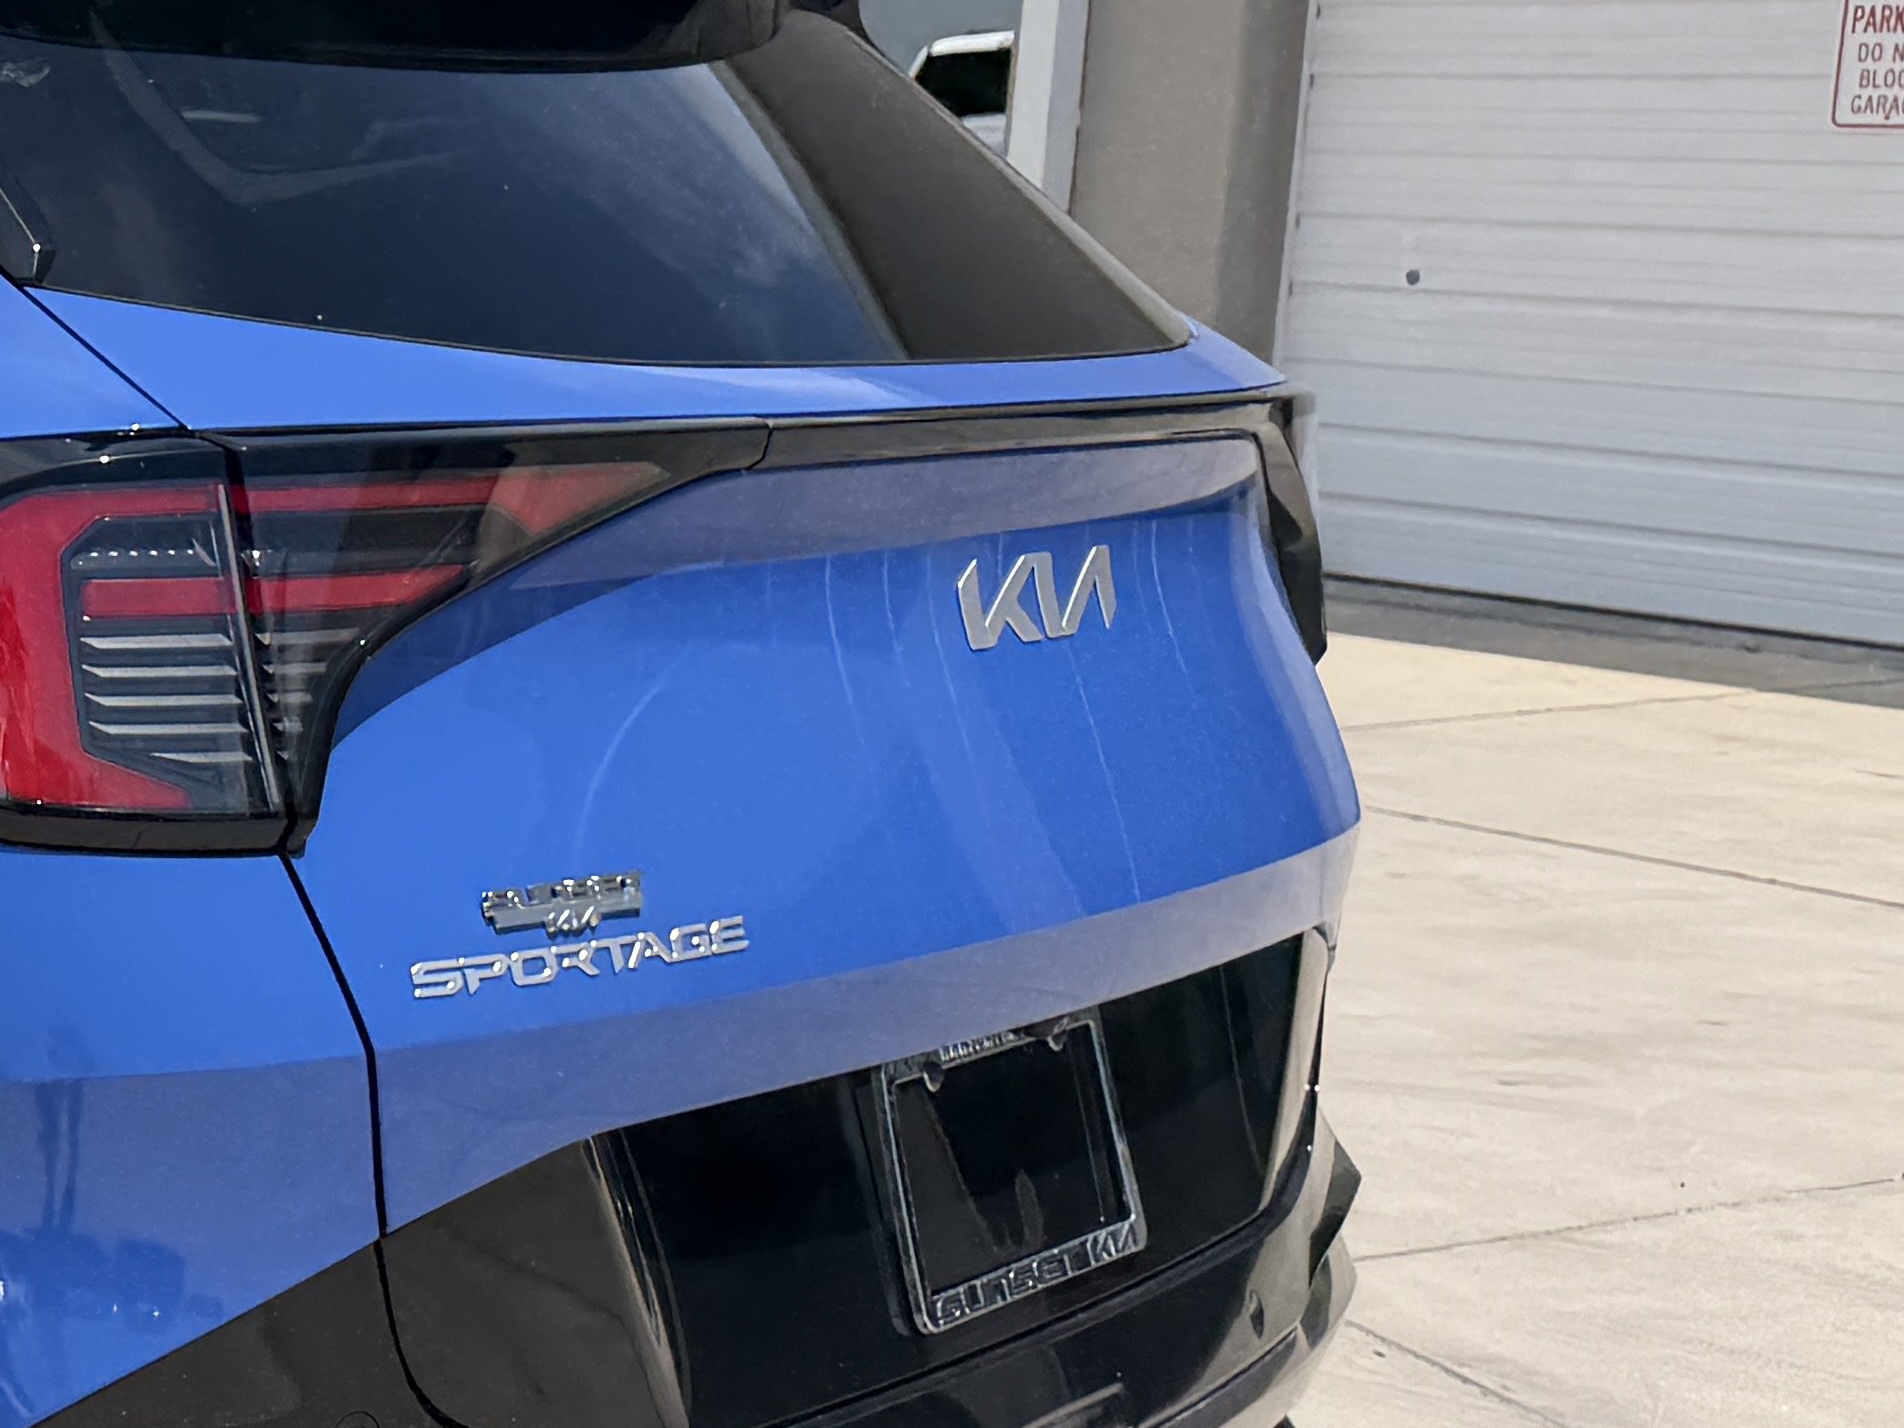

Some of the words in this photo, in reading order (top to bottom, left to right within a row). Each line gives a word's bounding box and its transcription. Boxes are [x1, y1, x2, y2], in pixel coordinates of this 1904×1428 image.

[1857, 43, 1883, 63] DO
[956, 544, 1117, 651] KIA
[410, 915, 750, 998] SPORTAGE
